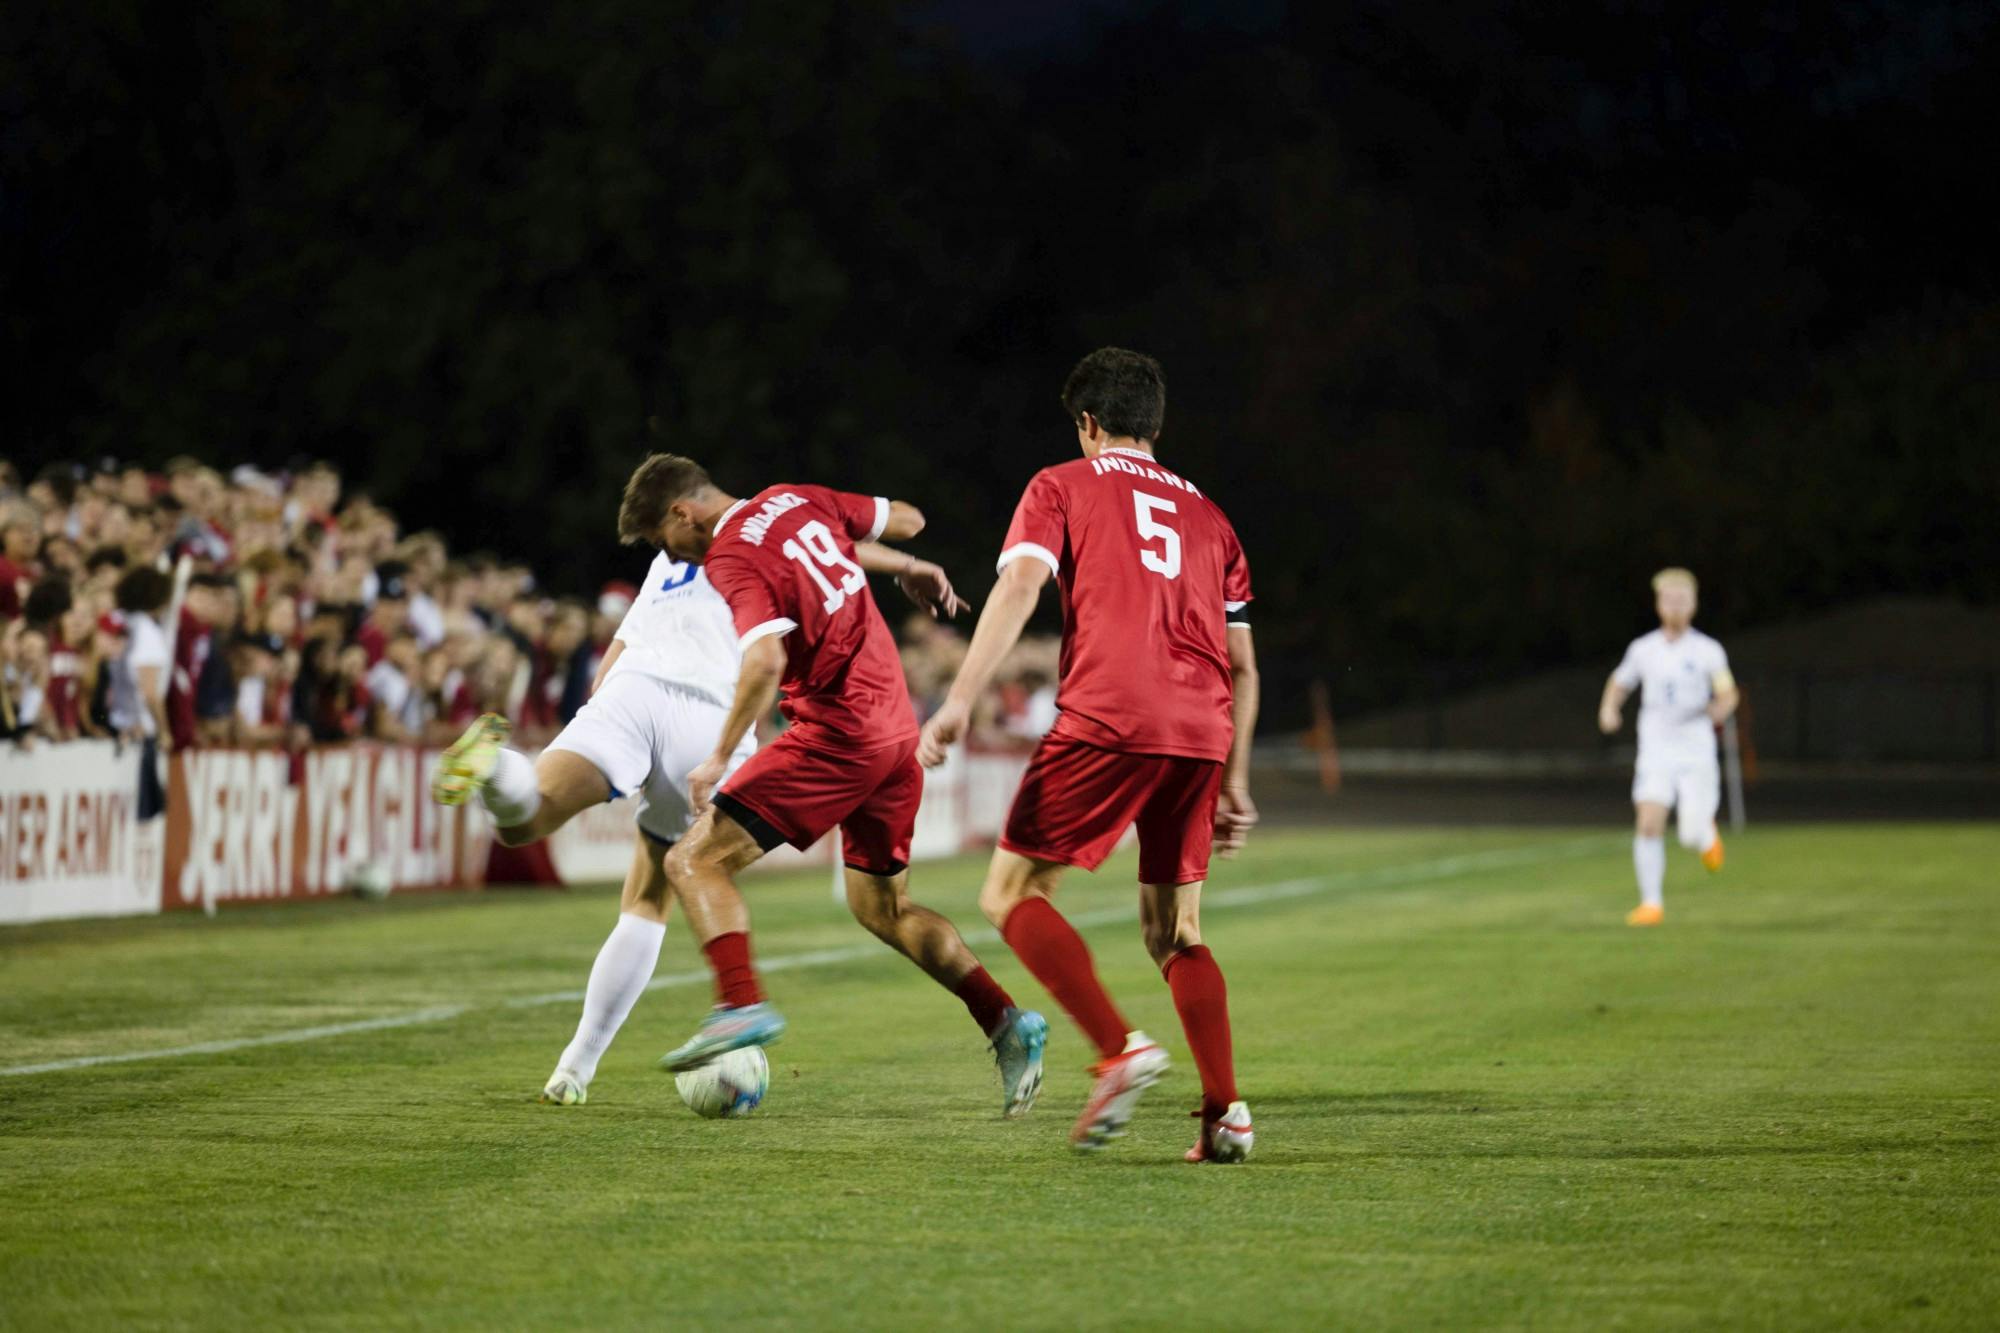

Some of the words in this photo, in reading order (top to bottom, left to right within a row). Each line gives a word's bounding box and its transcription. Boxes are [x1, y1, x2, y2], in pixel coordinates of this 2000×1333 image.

[1091, 456, 1203, 500] INDIANA
[782, 519, 867, 616] 19
[1132, 488, 1182, 580] 5
[0, 790, 49, 882] IER
